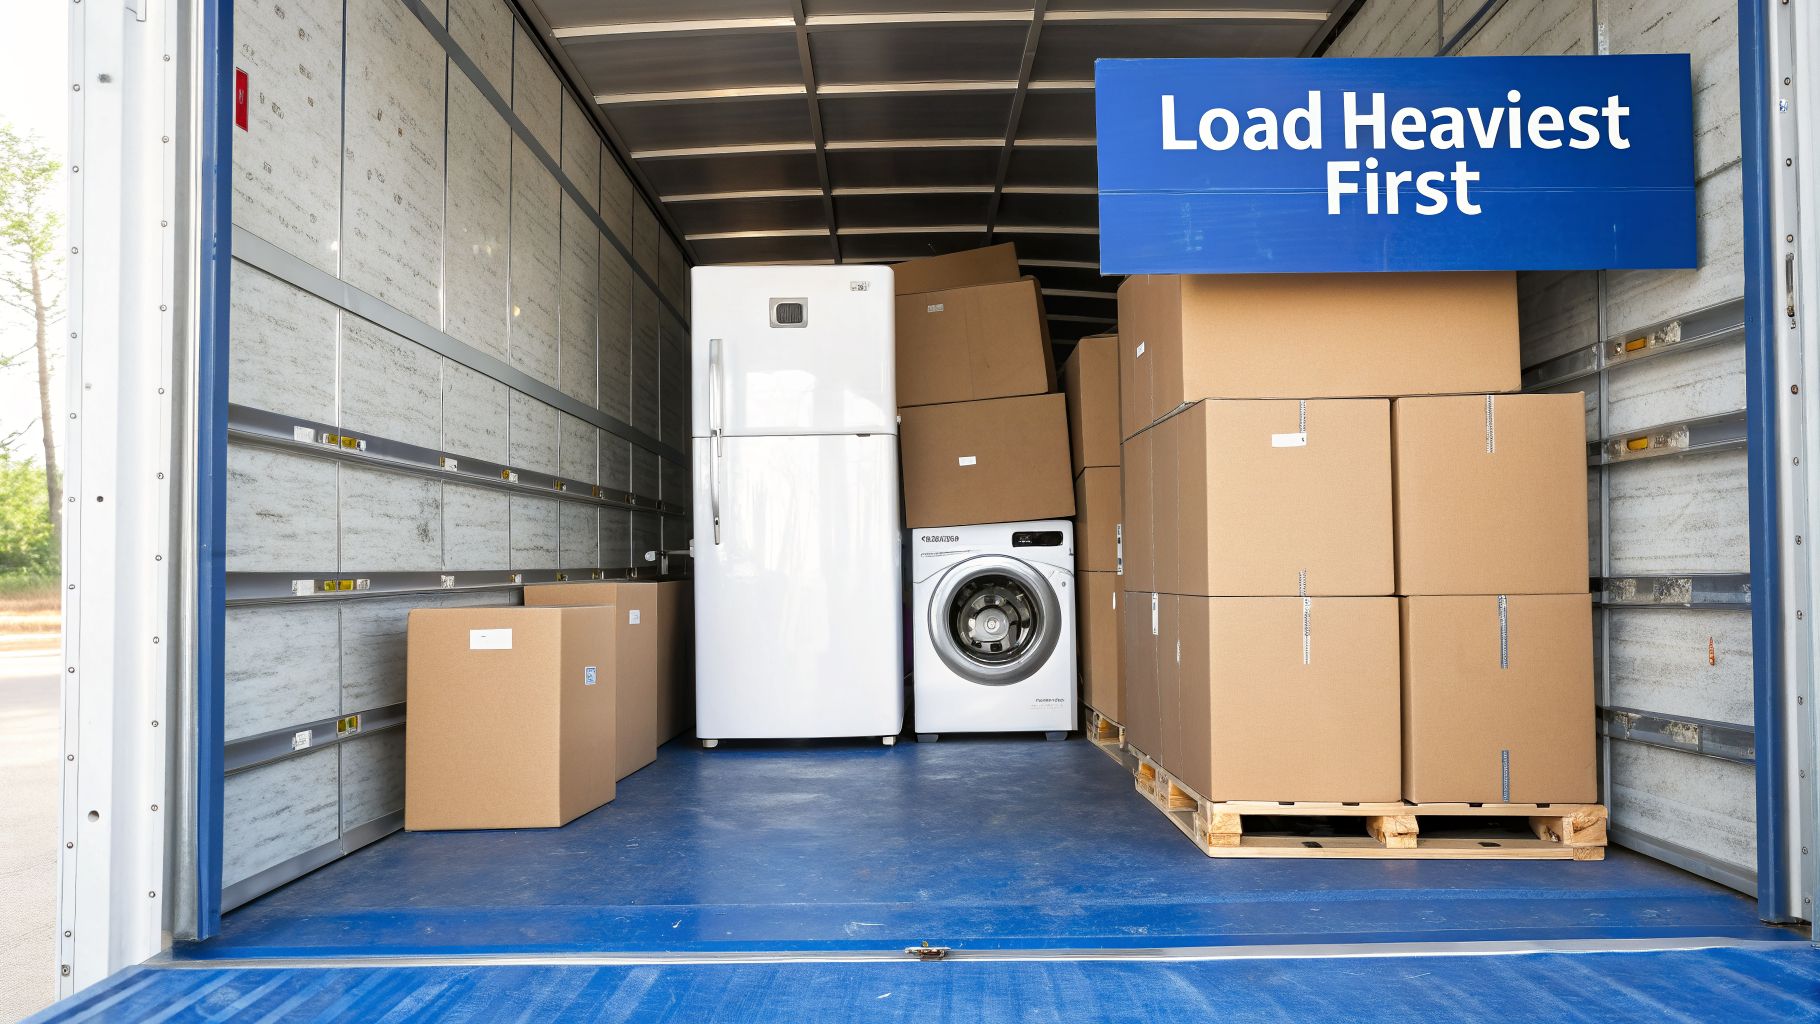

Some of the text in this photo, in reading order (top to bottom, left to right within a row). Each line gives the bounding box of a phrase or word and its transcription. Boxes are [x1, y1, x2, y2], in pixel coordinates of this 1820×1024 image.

[1161, 89, 1631, 151] Load Heaviest
[1326, 157, 1482, 216] First
